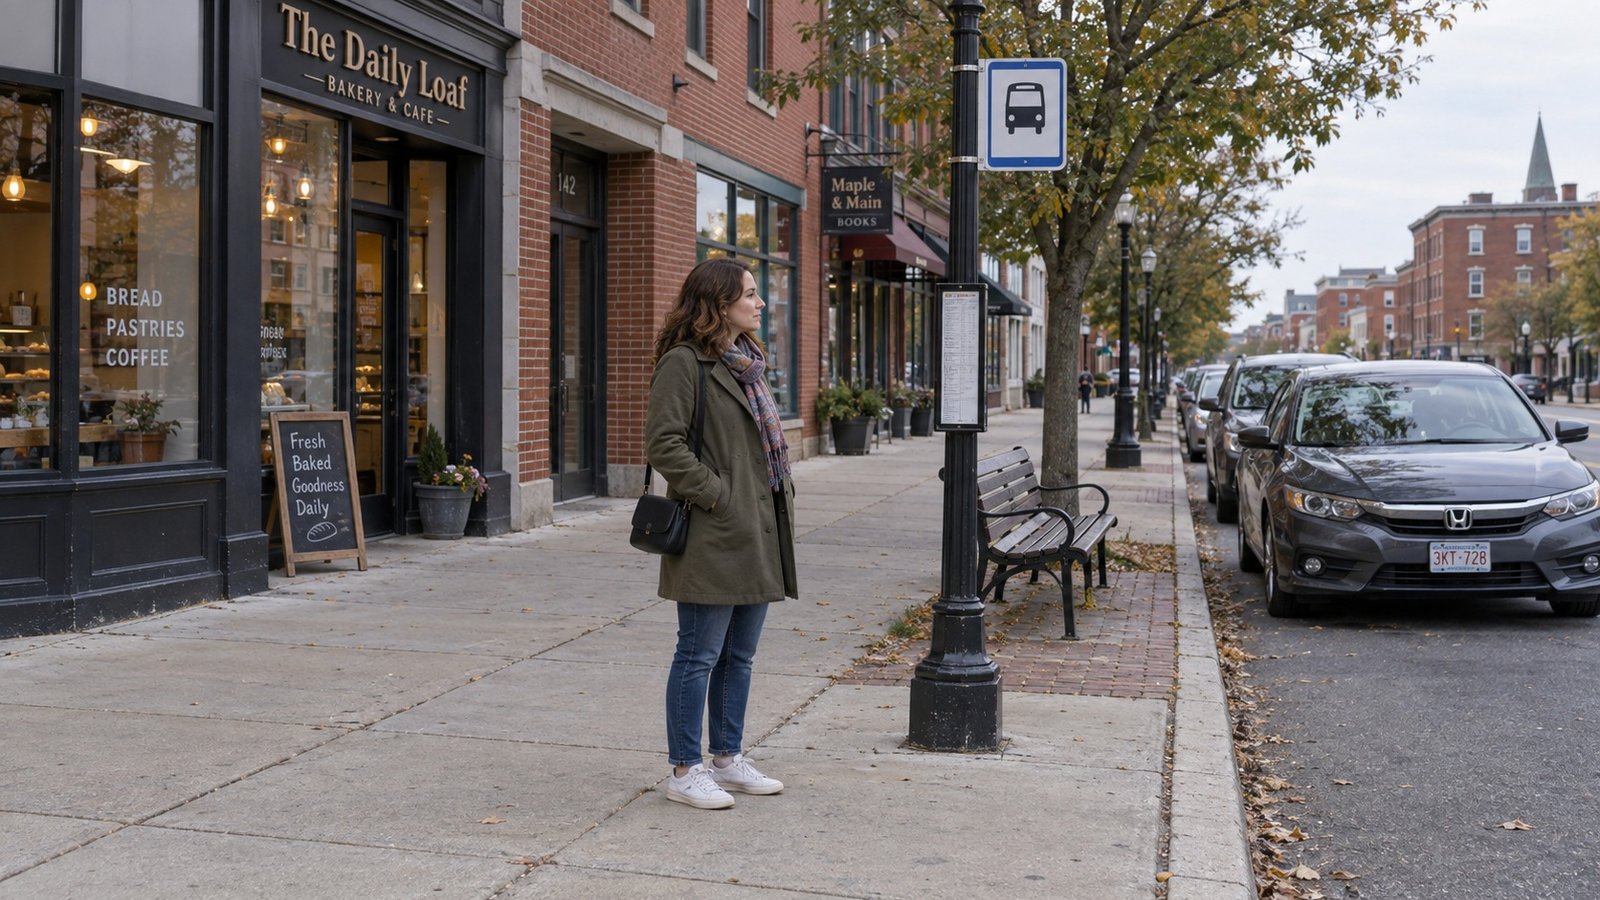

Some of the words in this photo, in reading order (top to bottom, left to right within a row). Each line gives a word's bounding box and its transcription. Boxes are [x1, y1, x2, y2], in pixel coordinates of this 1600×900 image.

[279, 3, 336, 62] The
[343, 29, 412, 98] Daily
[418, 59, 468, 110] Loaf
[327, 74, 382, 107] BAKERY
[388, 96, 397, 113] &
[403, 102, 434, 124] CAFE
[558, 172, 576, 196] 142
[831, 176, 876, 195] Maple
[831, 196, 843, 210] &
[846, 195, 882, 210] Main
[837, 217, 877, 227] BOOKS
[106, 286, 162, 307] BREAD
[106, 317, 185, 338] PASTRIES
[106, 348, 169, 367] COFFEE
[290, 431, 327, 450] Fresh
[292, 454, 332, 472] Baked
[292, 476, 345, 494] Goodness
[295, 498, 330, 519] Daily
